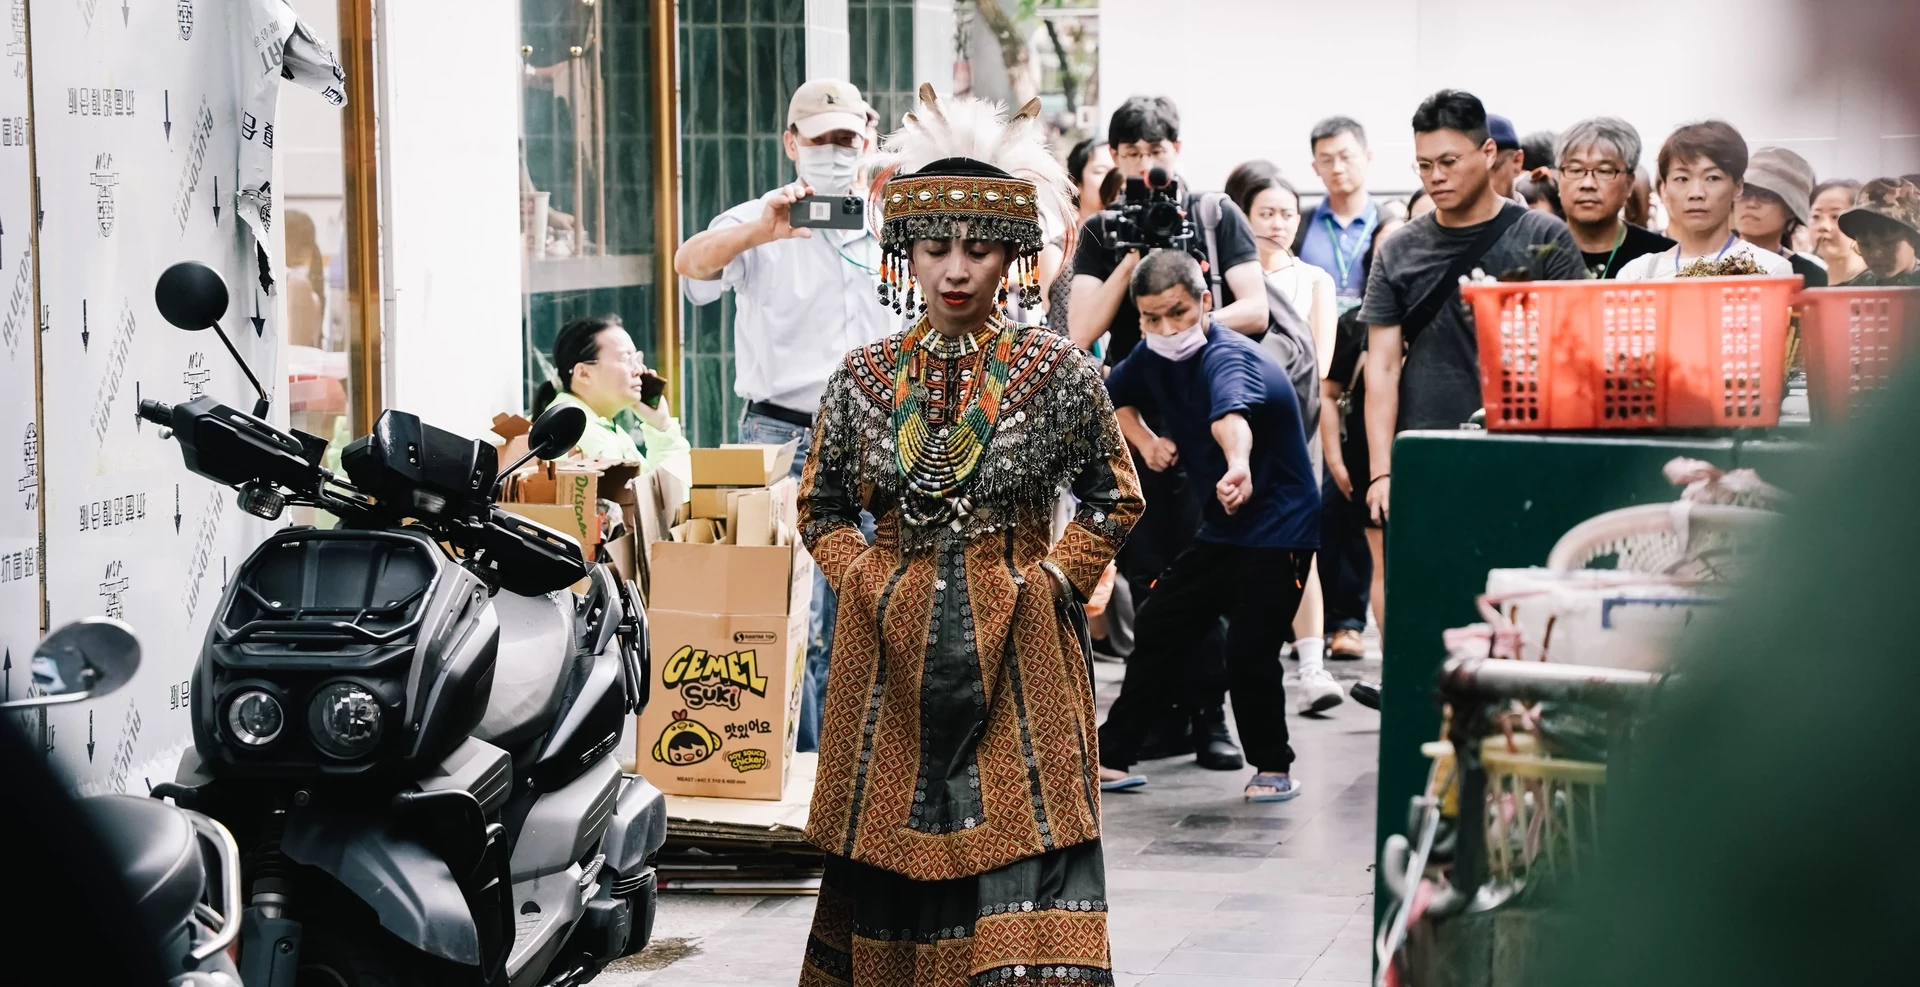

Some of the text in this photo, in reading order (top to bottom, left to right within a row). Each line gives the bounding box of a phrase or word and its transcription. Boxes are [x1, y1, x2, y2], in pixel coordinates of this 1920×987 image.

[177, 106, 214, 238] ALUCOMAT
[97, 309, 136, 449] ALUCOMAT
[187, 490, 224, 625] ALUCOMAT
[662, 645, 768, 698] GEMEZ
[114, 709, 142, 796] ALUCO
[724, 718, 772, 740] 맛있어요
[728, 749, 765, 760] soy sauce
[732, 755, 764, 767] chicken
